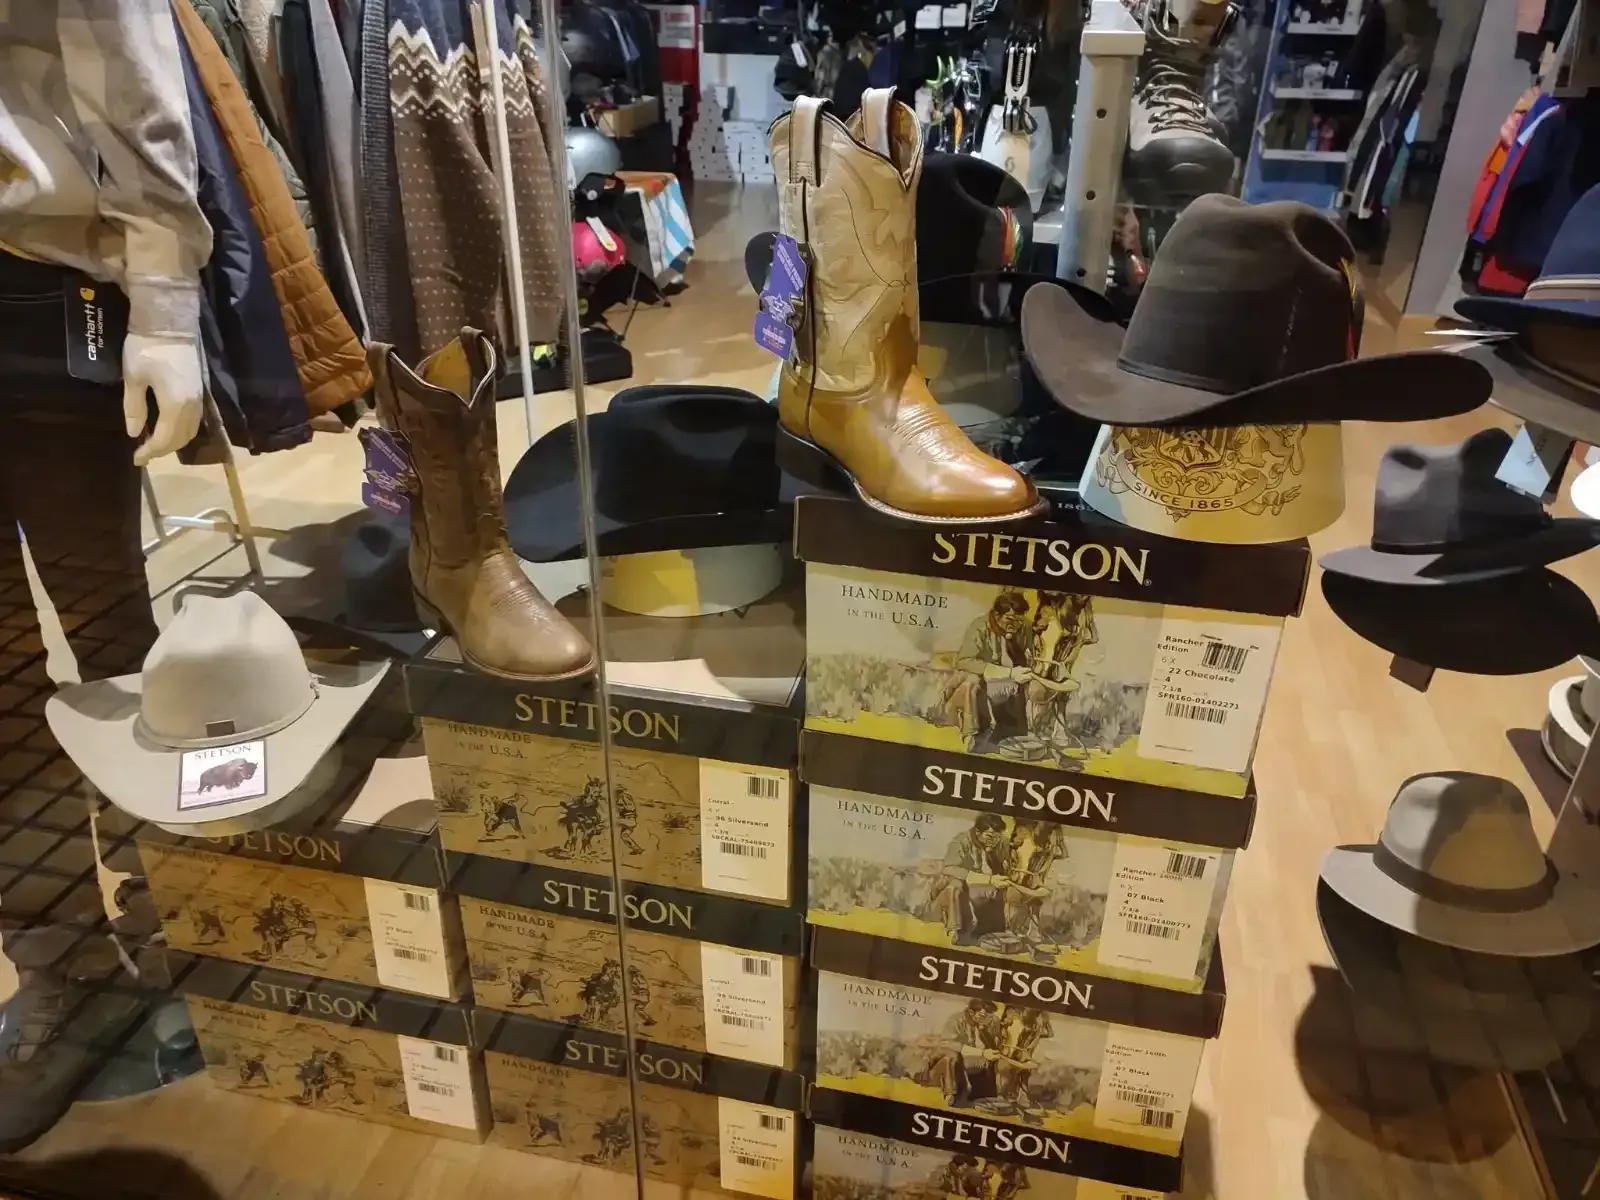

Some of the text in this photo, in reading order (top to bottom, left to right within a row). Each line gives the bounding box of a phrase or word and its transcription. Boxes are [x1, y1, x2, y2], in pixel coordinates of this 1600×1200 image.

[84, 302, 97, 361] carhartt
[1134, 482, 1234, 509] SINCE 1865
[932, 532, 1150, 586] STETSON
[841, 584, 949, 609] HANDMADE
[847, 608, 939, 629] IN THE U.S.A.
[1157, 643, 1189, 653] Edition
[1165, 635, 1205, 648] Rancher
[1161, 656, 1167, 664] 6
[1168, 667, 1236, 683] 22 Chocolate
[515, 693, 680, 744] STETSON
[448, 723, 532, 744] HANDMADE
[195, 744, 252, 760] STETSON
[922, 765, 1116, 822] STETSON
[727, 816, 769, 827] Silversand
[837, 799, 935, 824] HANDMADE
[843, 820, 854, 828] IN
[858, 821, 877, 831] THE
[207, 829, 341, 863] ETSON
[1116, 872, 1145, 882] Edition
[1123, 866, 1157, 877] Rancher
[543, 880, 693, 931] STETSON
[1127, 892, 1165, 904] 07 Black
[479, 905, 555, 929] HANDMADE
[919, 955, 1094, 1009] STETSON
[250, 981, 378, 1023] STETSON
[843, 983, 932, 1006] HANDMADE
[838, 1135, 919, 1158] HANDMADE
[911, 1112, 1071, 1164] STETSON
